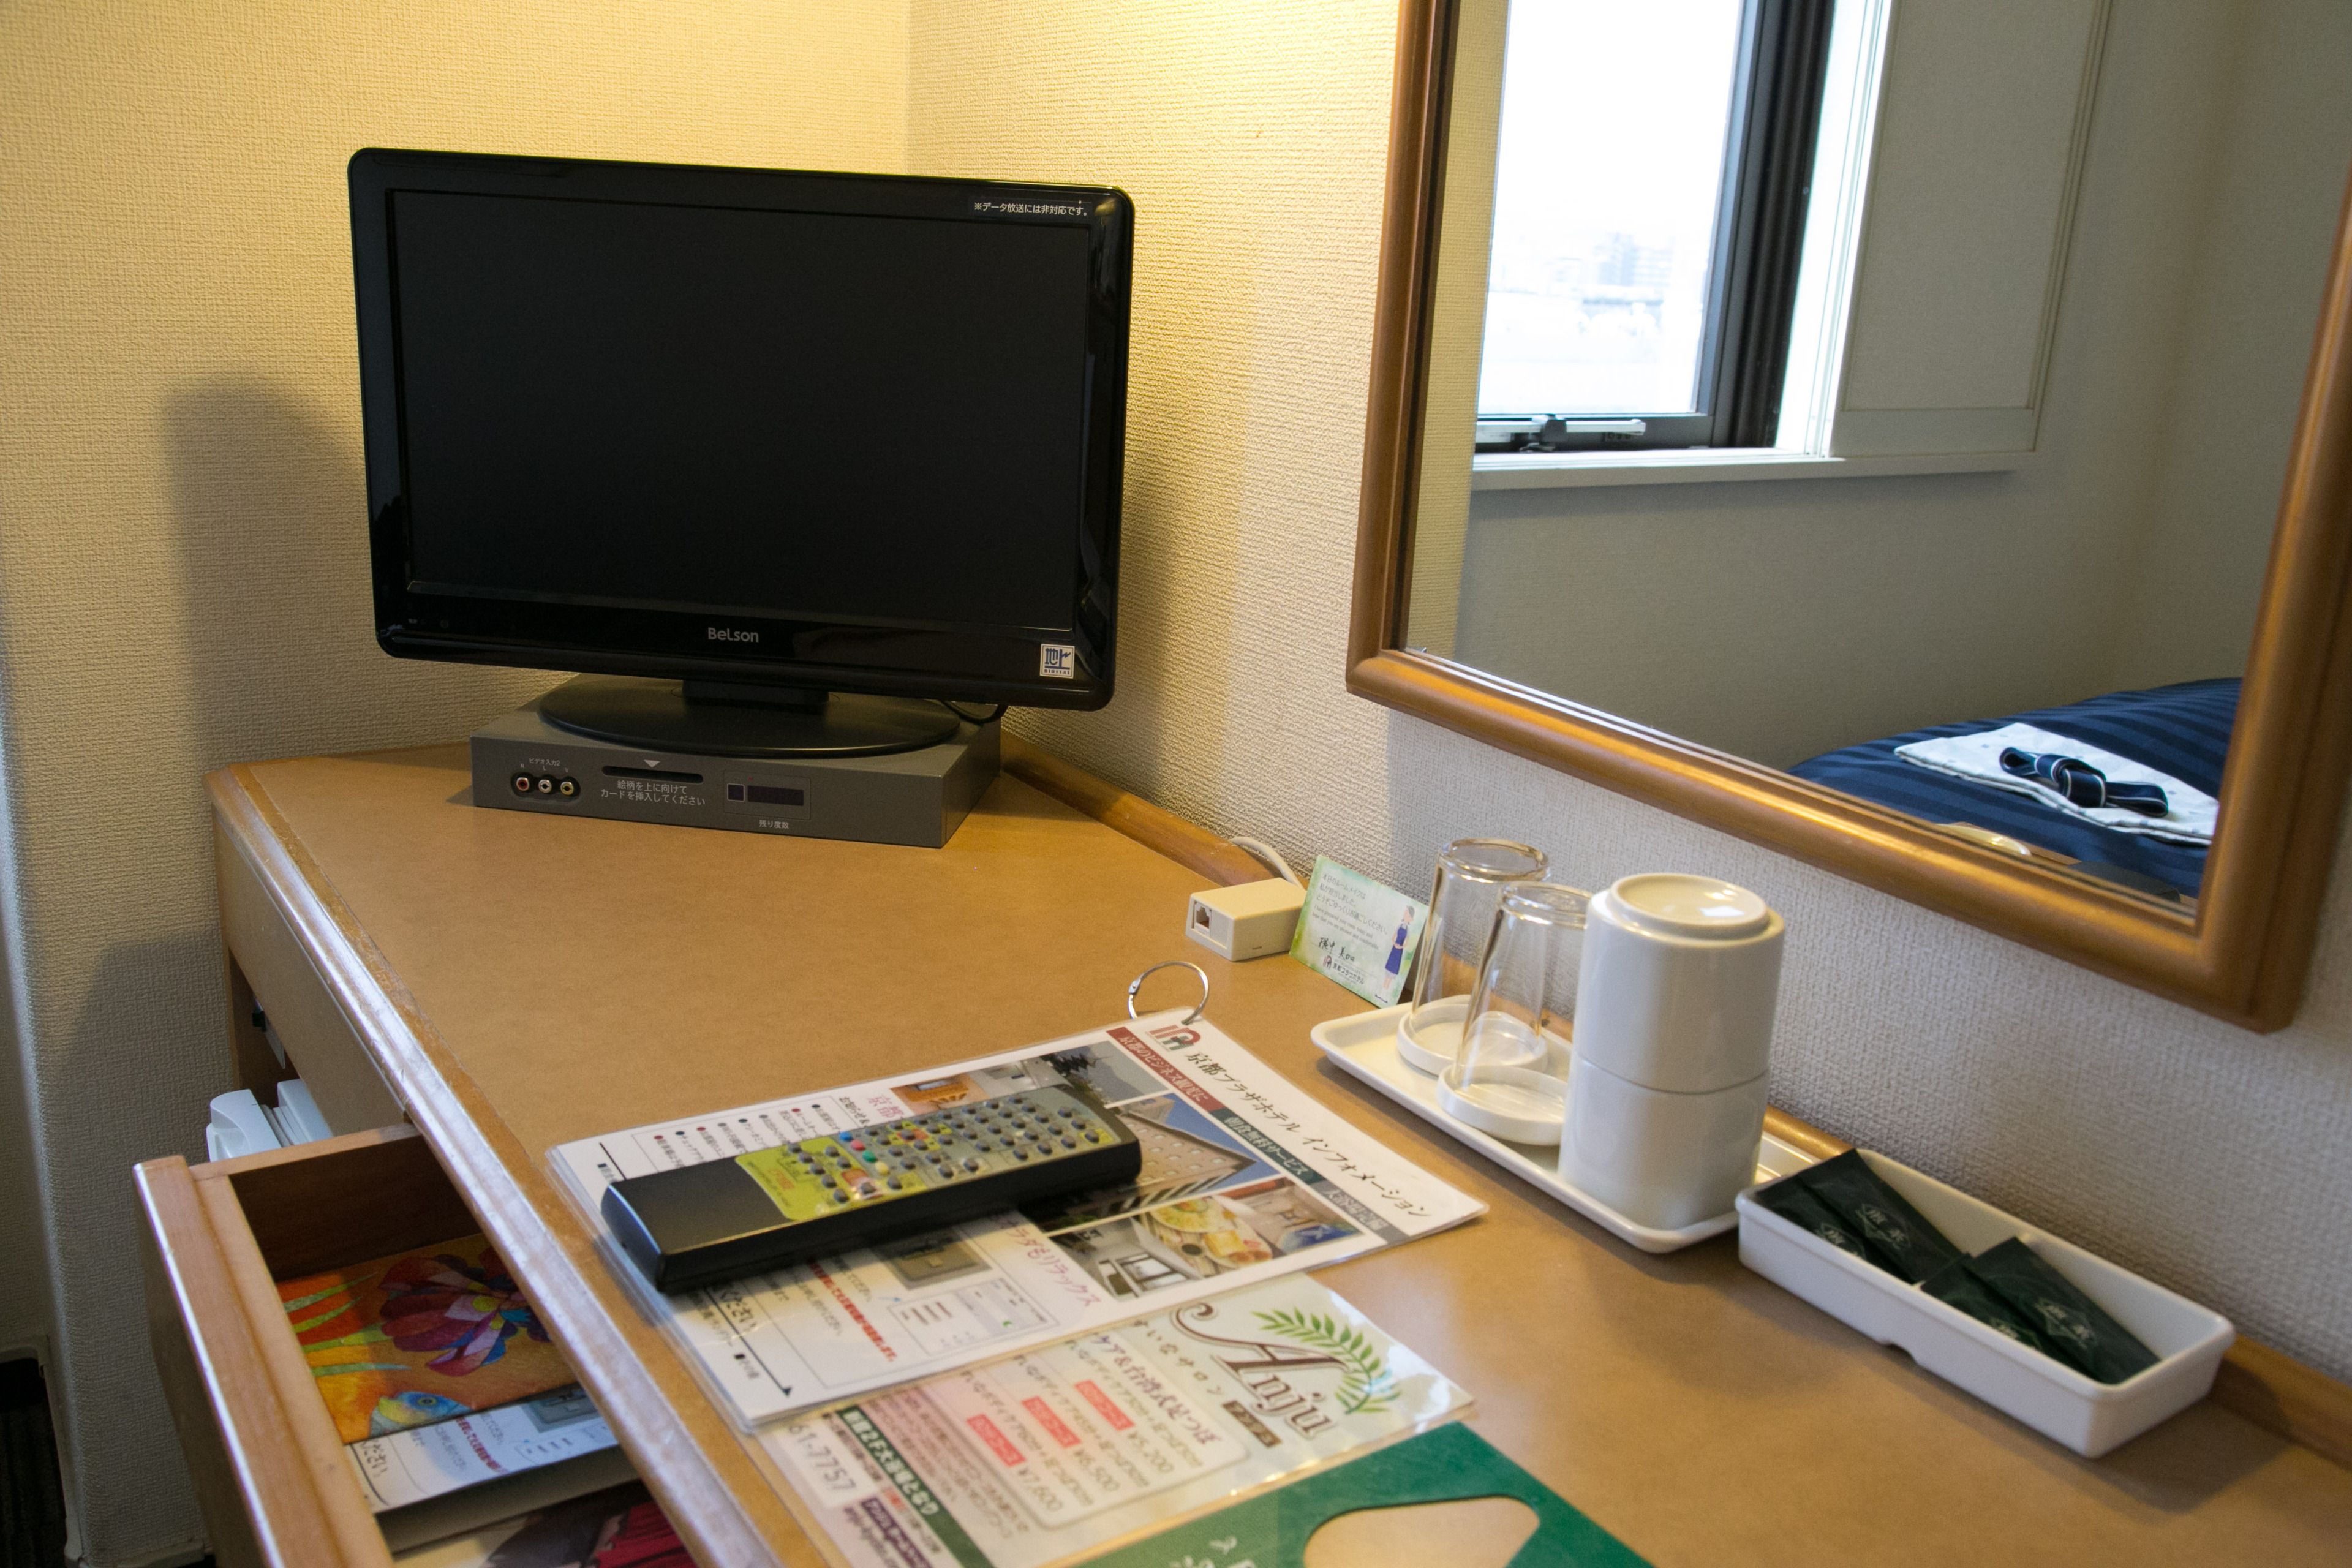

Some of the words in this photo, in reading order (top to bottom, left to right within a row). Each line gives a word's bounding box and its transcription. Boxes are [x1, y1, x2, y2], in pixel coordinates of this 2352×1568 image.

[974, 202, 1087, 216] ※データ放送には非対応です。
[600, 788, 706, 806] カードを挿入してください
[617, 780, 687, 795] 絵柄を上に向けて
[759, 819, 789, 829] 残り度数
[1120, 1036, 1208, 1101] 京都のビジネス観光に
[867, 1095, 904, 1118] 京都
[1186, 1052, 1302, 1134] 京都プラザホテル
[1303, 1136, 1432, 1217] インフォメーション
[1175, 1303, 1349, 1433] Anju
[1092, 1331, 1223, 1444] ケア&台湾式足つぼ
